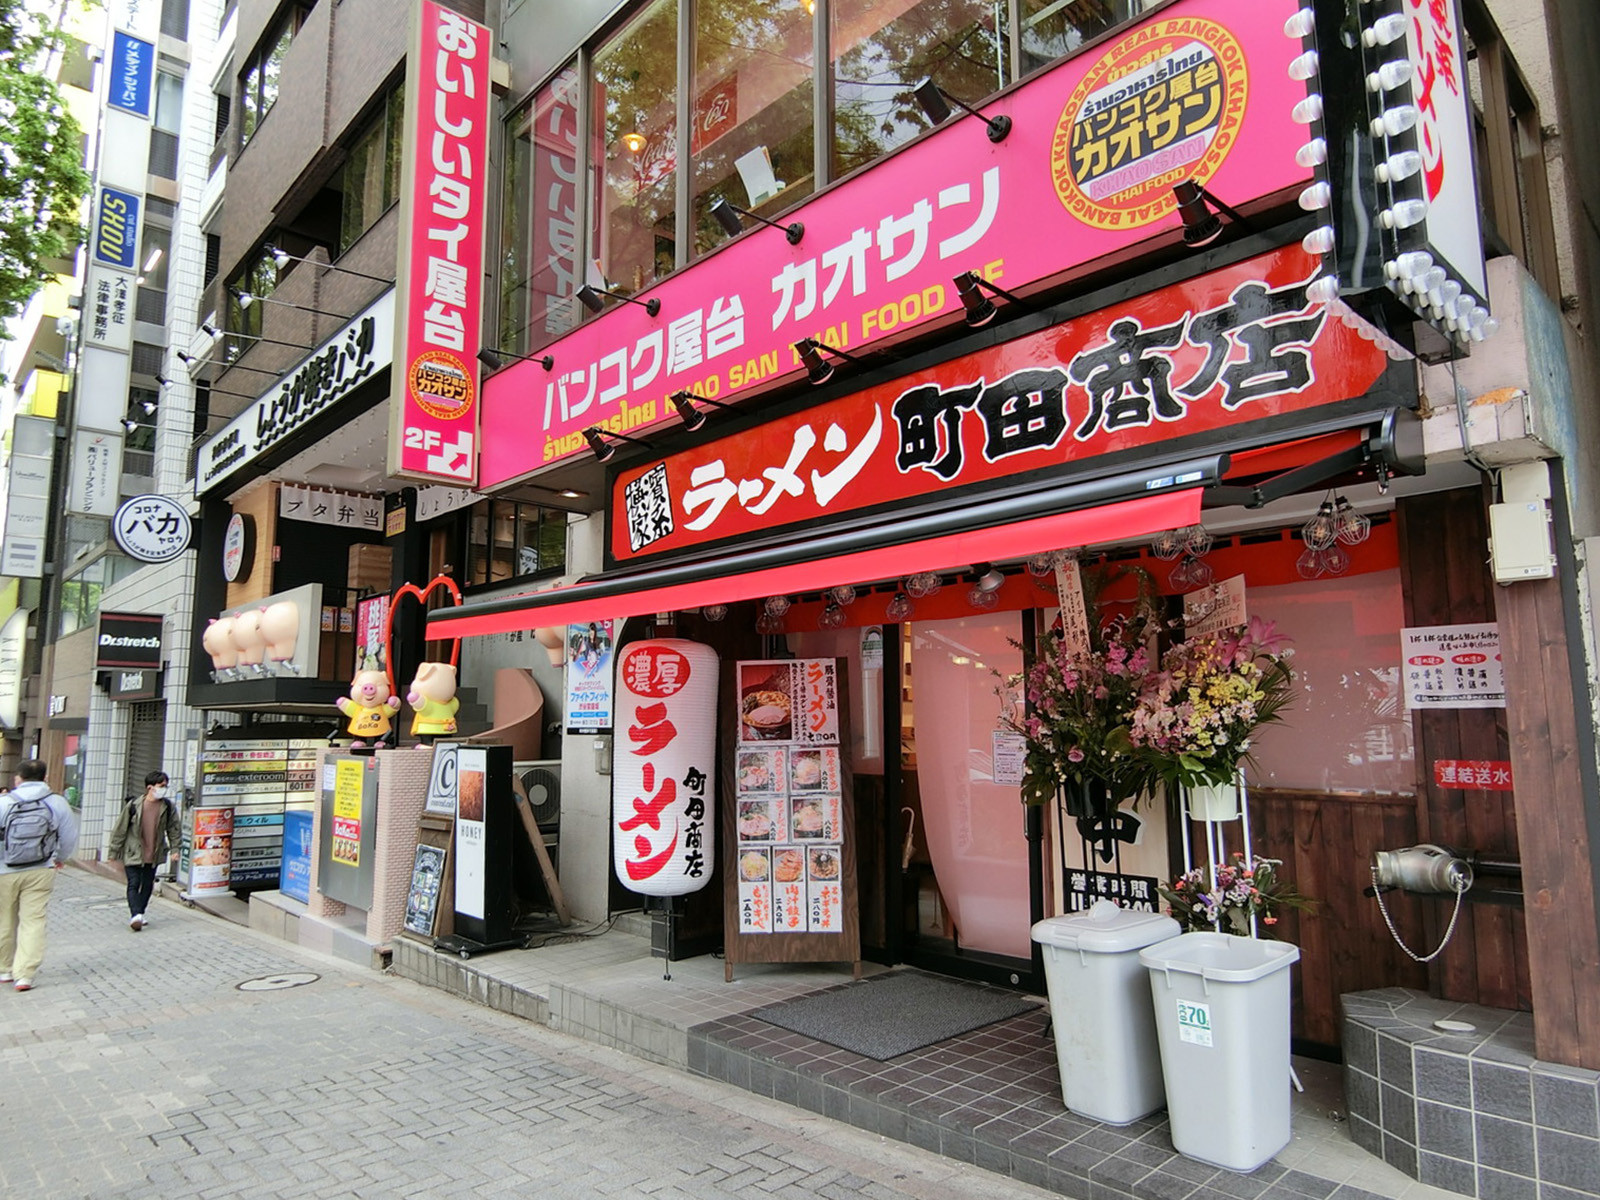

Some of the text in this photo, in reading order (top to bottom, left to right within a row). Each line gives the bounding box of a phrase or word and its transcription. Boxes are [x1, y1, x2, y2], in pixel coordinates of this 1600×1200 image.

[1112, 27, 1160, 61] REAL
[1165, 20, 1243, 77] BANGKOK
[1054, 62, 1109, 161] KHAOSAN
[1072, 60, 1219, 149] バンコク屋台
[1409, 0, 1445, 204] ーメン
[1075, 84, 1221, 184] カオサン
[424, 9, 477, 352] おいしいタイ屋台
[1054, 163, 1123, 226] BANGKOK
[1090, 135, 1206, 199] KHAO SAN
[1111, 167, 1185, 206] THAI FOOD
[99, 193, 128, 262] SHOU
[771, 166, 1000, 332] カオサン
[93, 279, 111, 341] 法律事務所
[256, 316, 375, 439] しょうが焼きバカ
[418, 369, 467, 388] バンコク屋台
[543, 294, 745, 431] バンコク屋台
[664, 374, 720, 415] KAO
[728, 350, 779, 389] SAN
[788, 321, 849, 365] TAI
[862, 284, 946, 339] FOOD
[893, 272, 1328, 482] 町田商店
[418, 378, 467, 401] カオサン
[404, 426, 441, 451] 2F
[682, 402, 883, 531] ラーメン
[126, 512, 180, 535] バカ
[134, 504, 161, 514] コロナ
[100, 634, 161, 648] Dr.stretch
[628, 652, 682, 694] 濃厚
[807, 662, 827, 732] ラーメン
[205, 774, 216, 783] 8F
[239, 770, 284, 781] exteroom
[441, 759, 454, 789] C
[618, 702, 679, 881] ラーメン
[1440, 766, 1510, 785] 連結送水
[461, 825, 482, 840] HONEY
[683, 766, 706, 878] 町田商店
